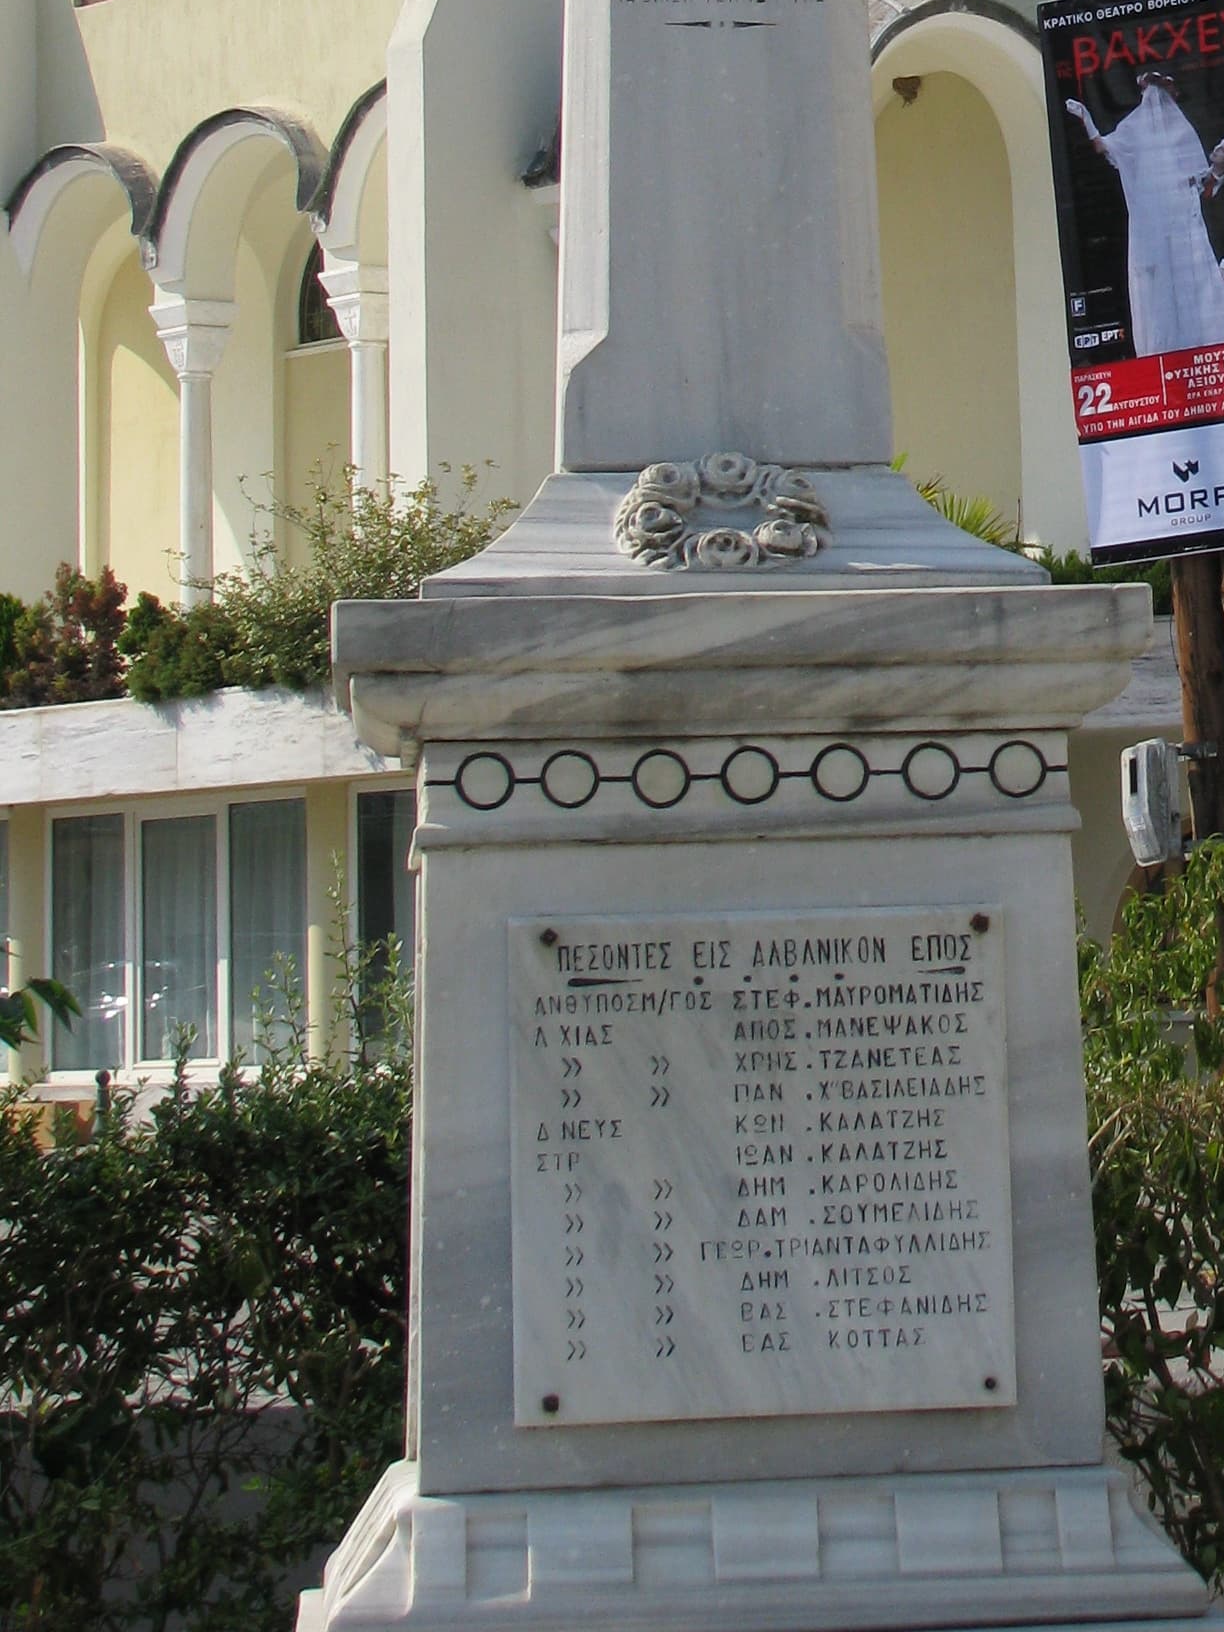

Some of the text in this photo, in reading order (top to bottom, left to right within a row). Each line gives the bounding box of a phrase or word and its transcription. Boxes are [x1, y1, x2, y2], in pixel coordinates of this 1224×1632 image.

[1044, 11, 1093, 30] ΚΡΑΤΙΚΟ
[1096, 2, 1143, 20] ΘΕΑΤΡΟ
[1164, 363, 1221, 381] ΦΥΣΙΚΗΣ
[1078, 382, 1160, 417] 22 ΑΥΓΟΥΣΤΟΥ
[1083, 421, 1104, 434] ΥΠΟ
[1107, 417, 1126, 430] ΤΗΝ
[1128, 412, 1159, 427] ΑΙΓΙΔΑ
[1163, 408, 1180, 420] ΤΟΥ
[1183, 402, 1217, 418] ΔΗΜΟΥ
[1170, 513, 1212, 526] GROUP
[557, 934, 972, 972] ΠΕΣΟΝΤΕΣ ΕΙΣ ΑΛΒΑΝΙΚΟΝ ΕΠΟΣ
[535, 989, 712, 1016] ΑΝΘΥΠΟΣΜ/ΓΟΣ
[816, 982, 984, 1008] ΜΑΥΡΟΜΑΤΙΔΗΣ
[560, 1024, 613, 1047] ΧΙΑΣ
[816, 1013, 969, 1039] ΜΑΝΕΨΑΚΟΣ
[820, 1046, 961, 1069] ΤΖΑΝΕΤΕΑΣ
[537, 1123, 550, 1141] Δ
[561, 1119, 622, 1140] ΝΕΥΣ
[820, 1108, 945, 1132] ΚΑΛΑΤΖΗΣ
[537, 1151, 580, 1172] ΣΤΡ
[821, 1139, 948, 1163] ΚΑΛΑΤΖΗΣ
[822, 1170, 958, 1194] ΚΑΡΟΛΙΔΗΣ
[823, 1200, 979, 1225] ΣΟΥΜΕΛΙΔΗΣ
[774, 1231, 990, 1258] ΤΡΙΑΝΤΑΦΥΛΛΙΔΗΣ
[827, 1265, 912, 1288] ΛΙΤΣΟΣ
[828, 1294, 988, 1319] ΣΤΕΦΑΝΙΔΗΣ
[829, 1327, 926, 1349] ΚΟΤΤΑΣ
